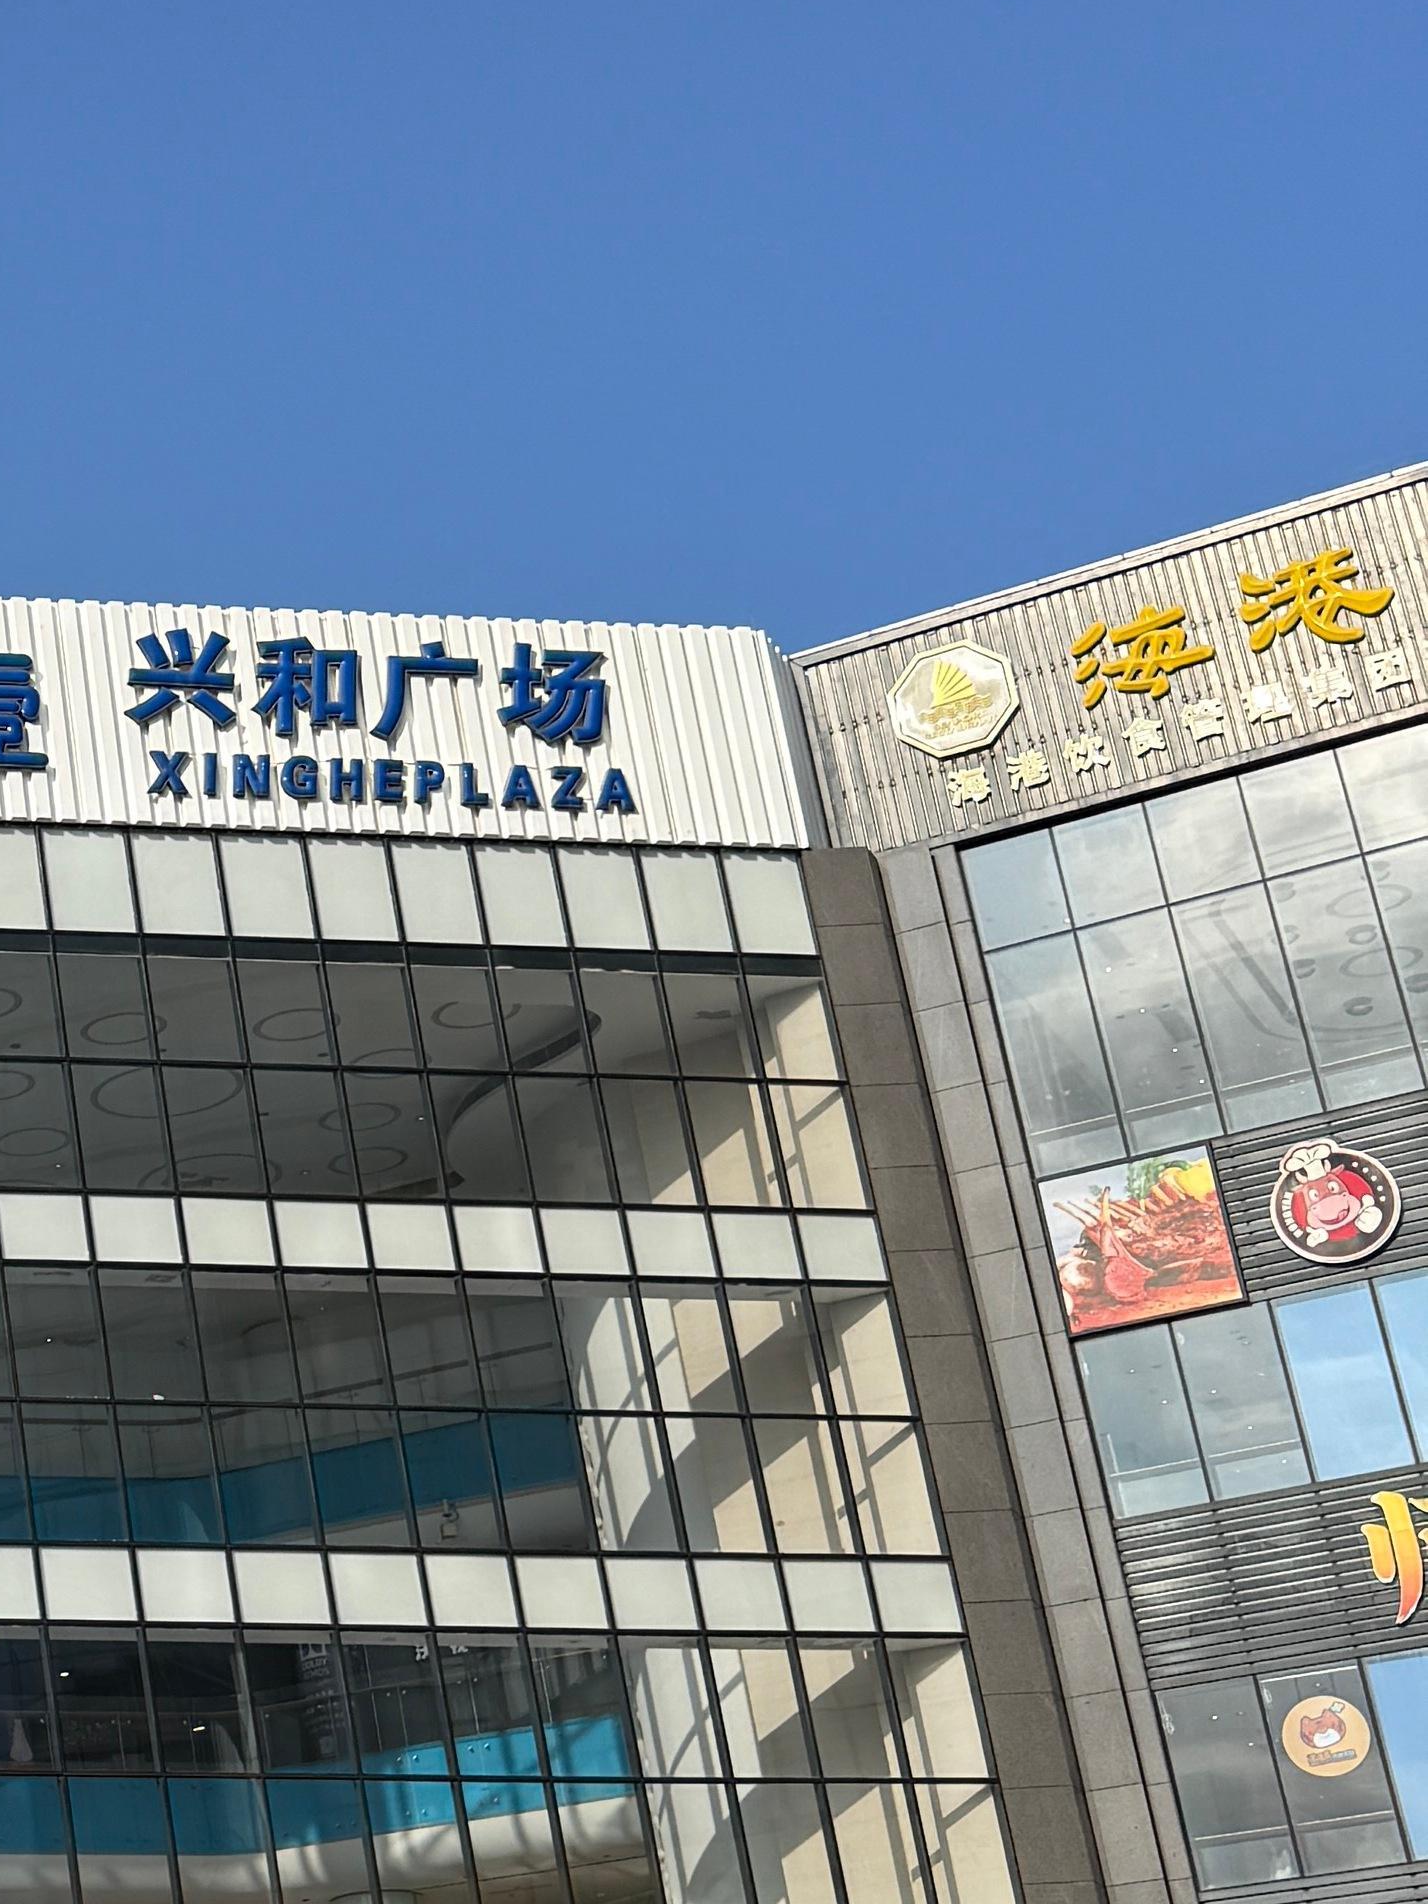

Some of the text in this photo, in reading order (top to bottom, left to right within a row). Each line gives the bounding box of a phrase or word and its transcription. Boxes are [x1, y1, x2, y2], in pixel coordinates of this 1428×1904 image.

[123, 628, 608, 746] 兴和广场
[147, 750, 637, 814] XINGHEPLAZA
